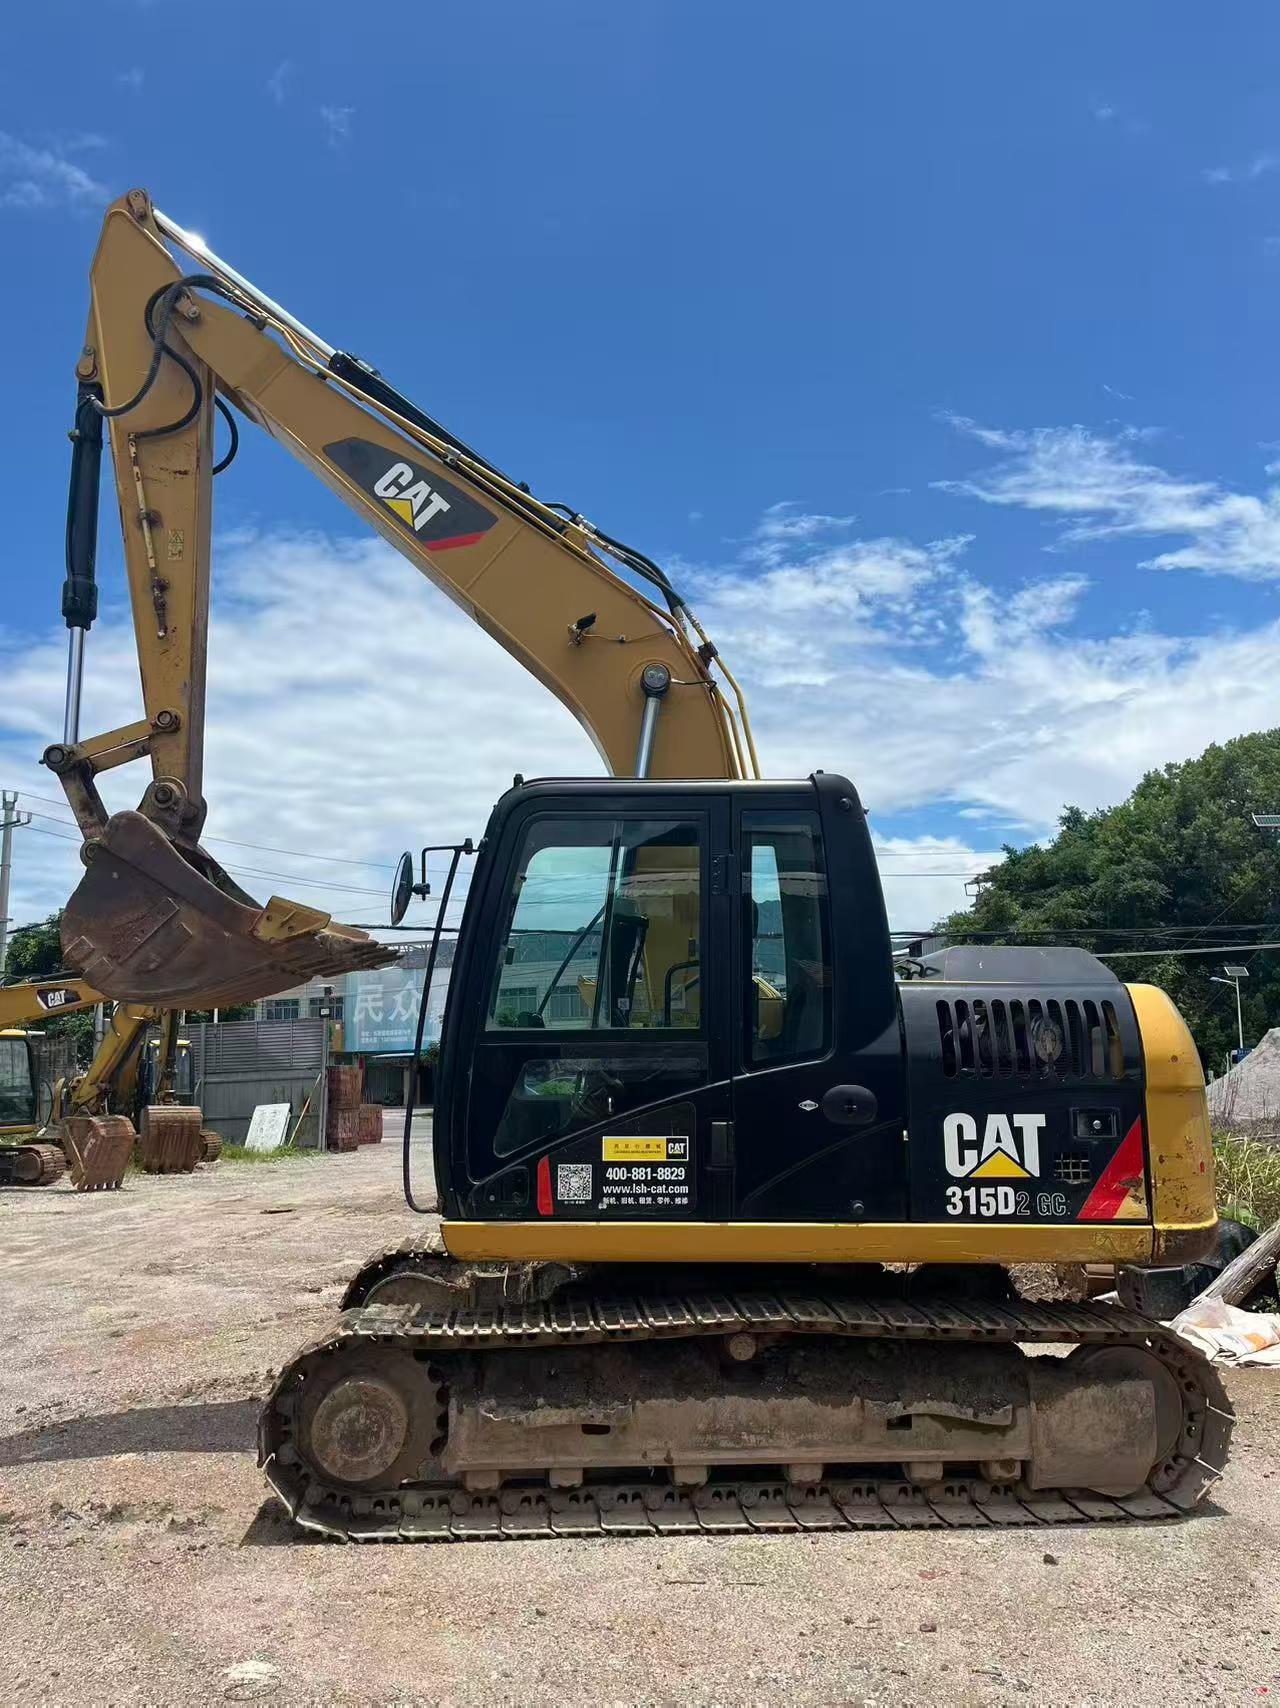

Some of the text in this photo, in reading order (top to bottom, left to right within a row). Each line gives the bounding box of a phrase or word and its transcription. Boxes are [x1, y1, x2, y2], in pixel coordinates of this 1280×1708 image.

[373, 462, 451, 532] CAT
[47, 990, 66, 1008] CAT
[667, 1142, 686, 1155] CAT
[943, 1112, 1046, 1178] CAT
[605, 1167, 686, 1181] 400-881-8829
[602, 1183, 689, 1194] www.lsh-cat.com
[1036, 1192, 1067, 1216] GC
